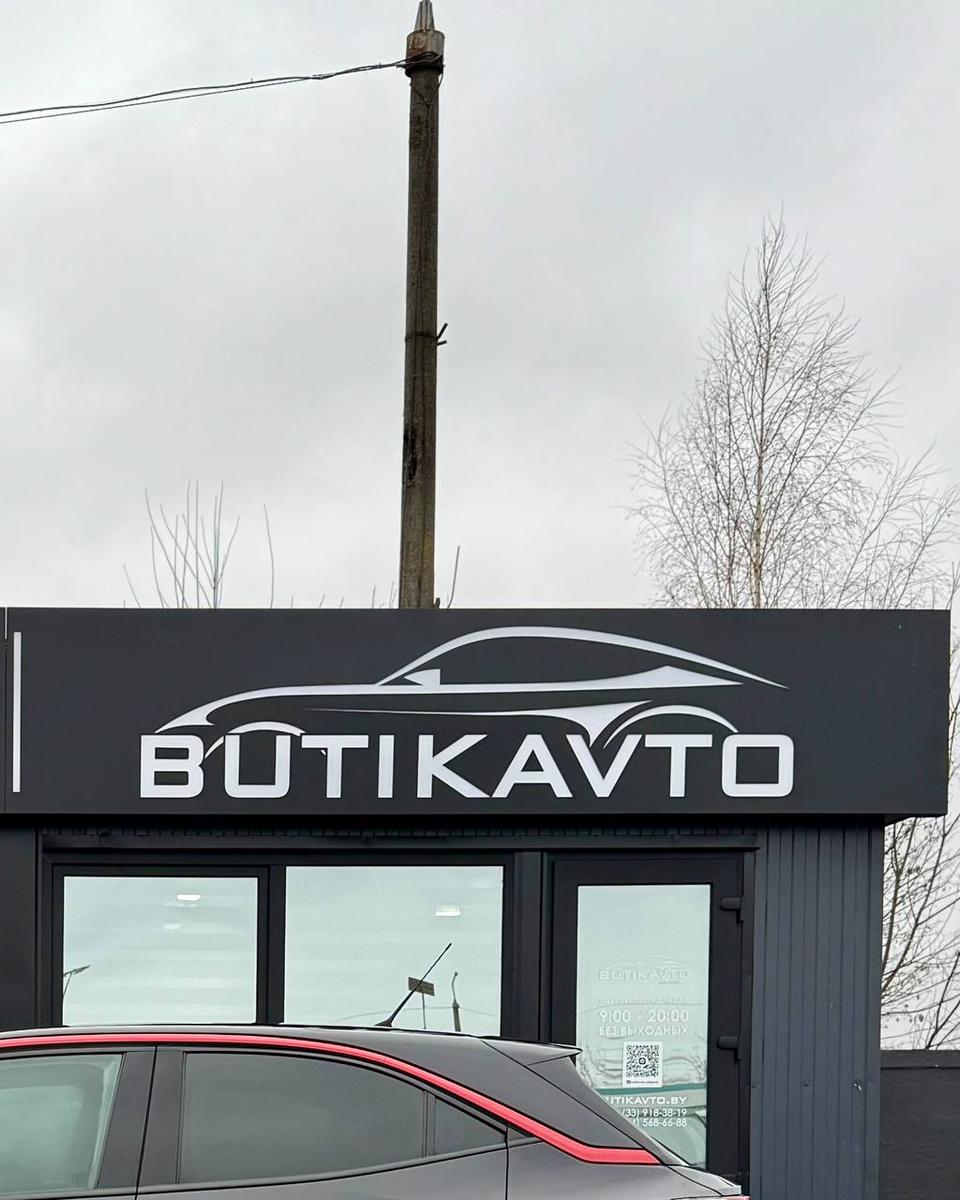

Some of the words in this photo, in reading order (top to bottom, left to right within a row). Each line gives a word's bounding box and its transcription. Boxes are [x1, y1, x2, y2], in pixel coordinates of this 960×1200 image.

[140, 734, 795, 799] BUTIKAVTO
[599, 1009, 632, 1023] 9:00
[647, 1009, 689, 1023] 20:00
[642, 1108, 688, 1117] 918-38-19
[642, 1117, 688, 1127] 568-66-88
